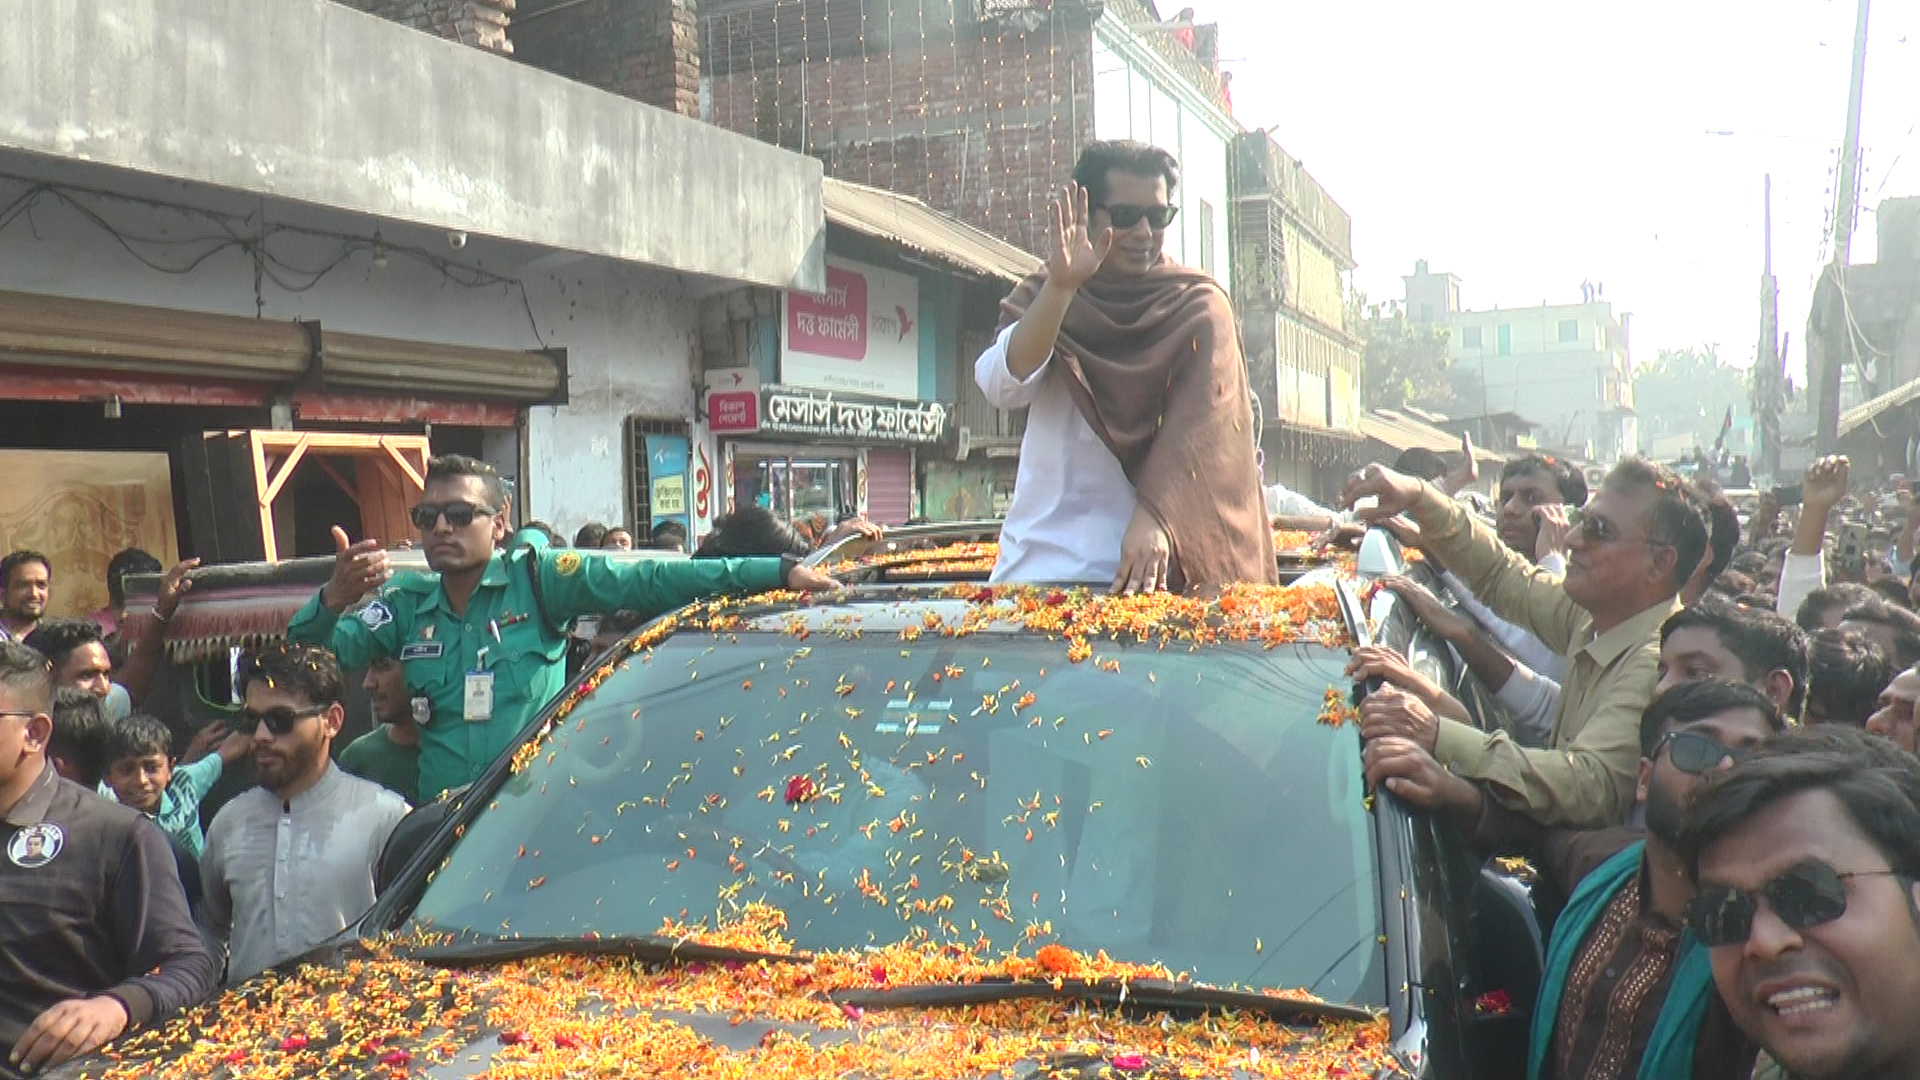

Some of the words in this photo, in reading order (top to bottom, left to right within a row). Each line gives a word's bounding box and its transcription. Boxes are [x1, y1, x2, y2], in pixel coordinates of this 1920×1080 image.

[796, 310, 815, 336] দত্ত
[817, 312, 860, 341] ফার্মেসী
[769, 393, 832, 427] মেসার্স
[838, 401, 876, 430] দত্ত
[876, 402, 945, 438] ফার্মেসী
